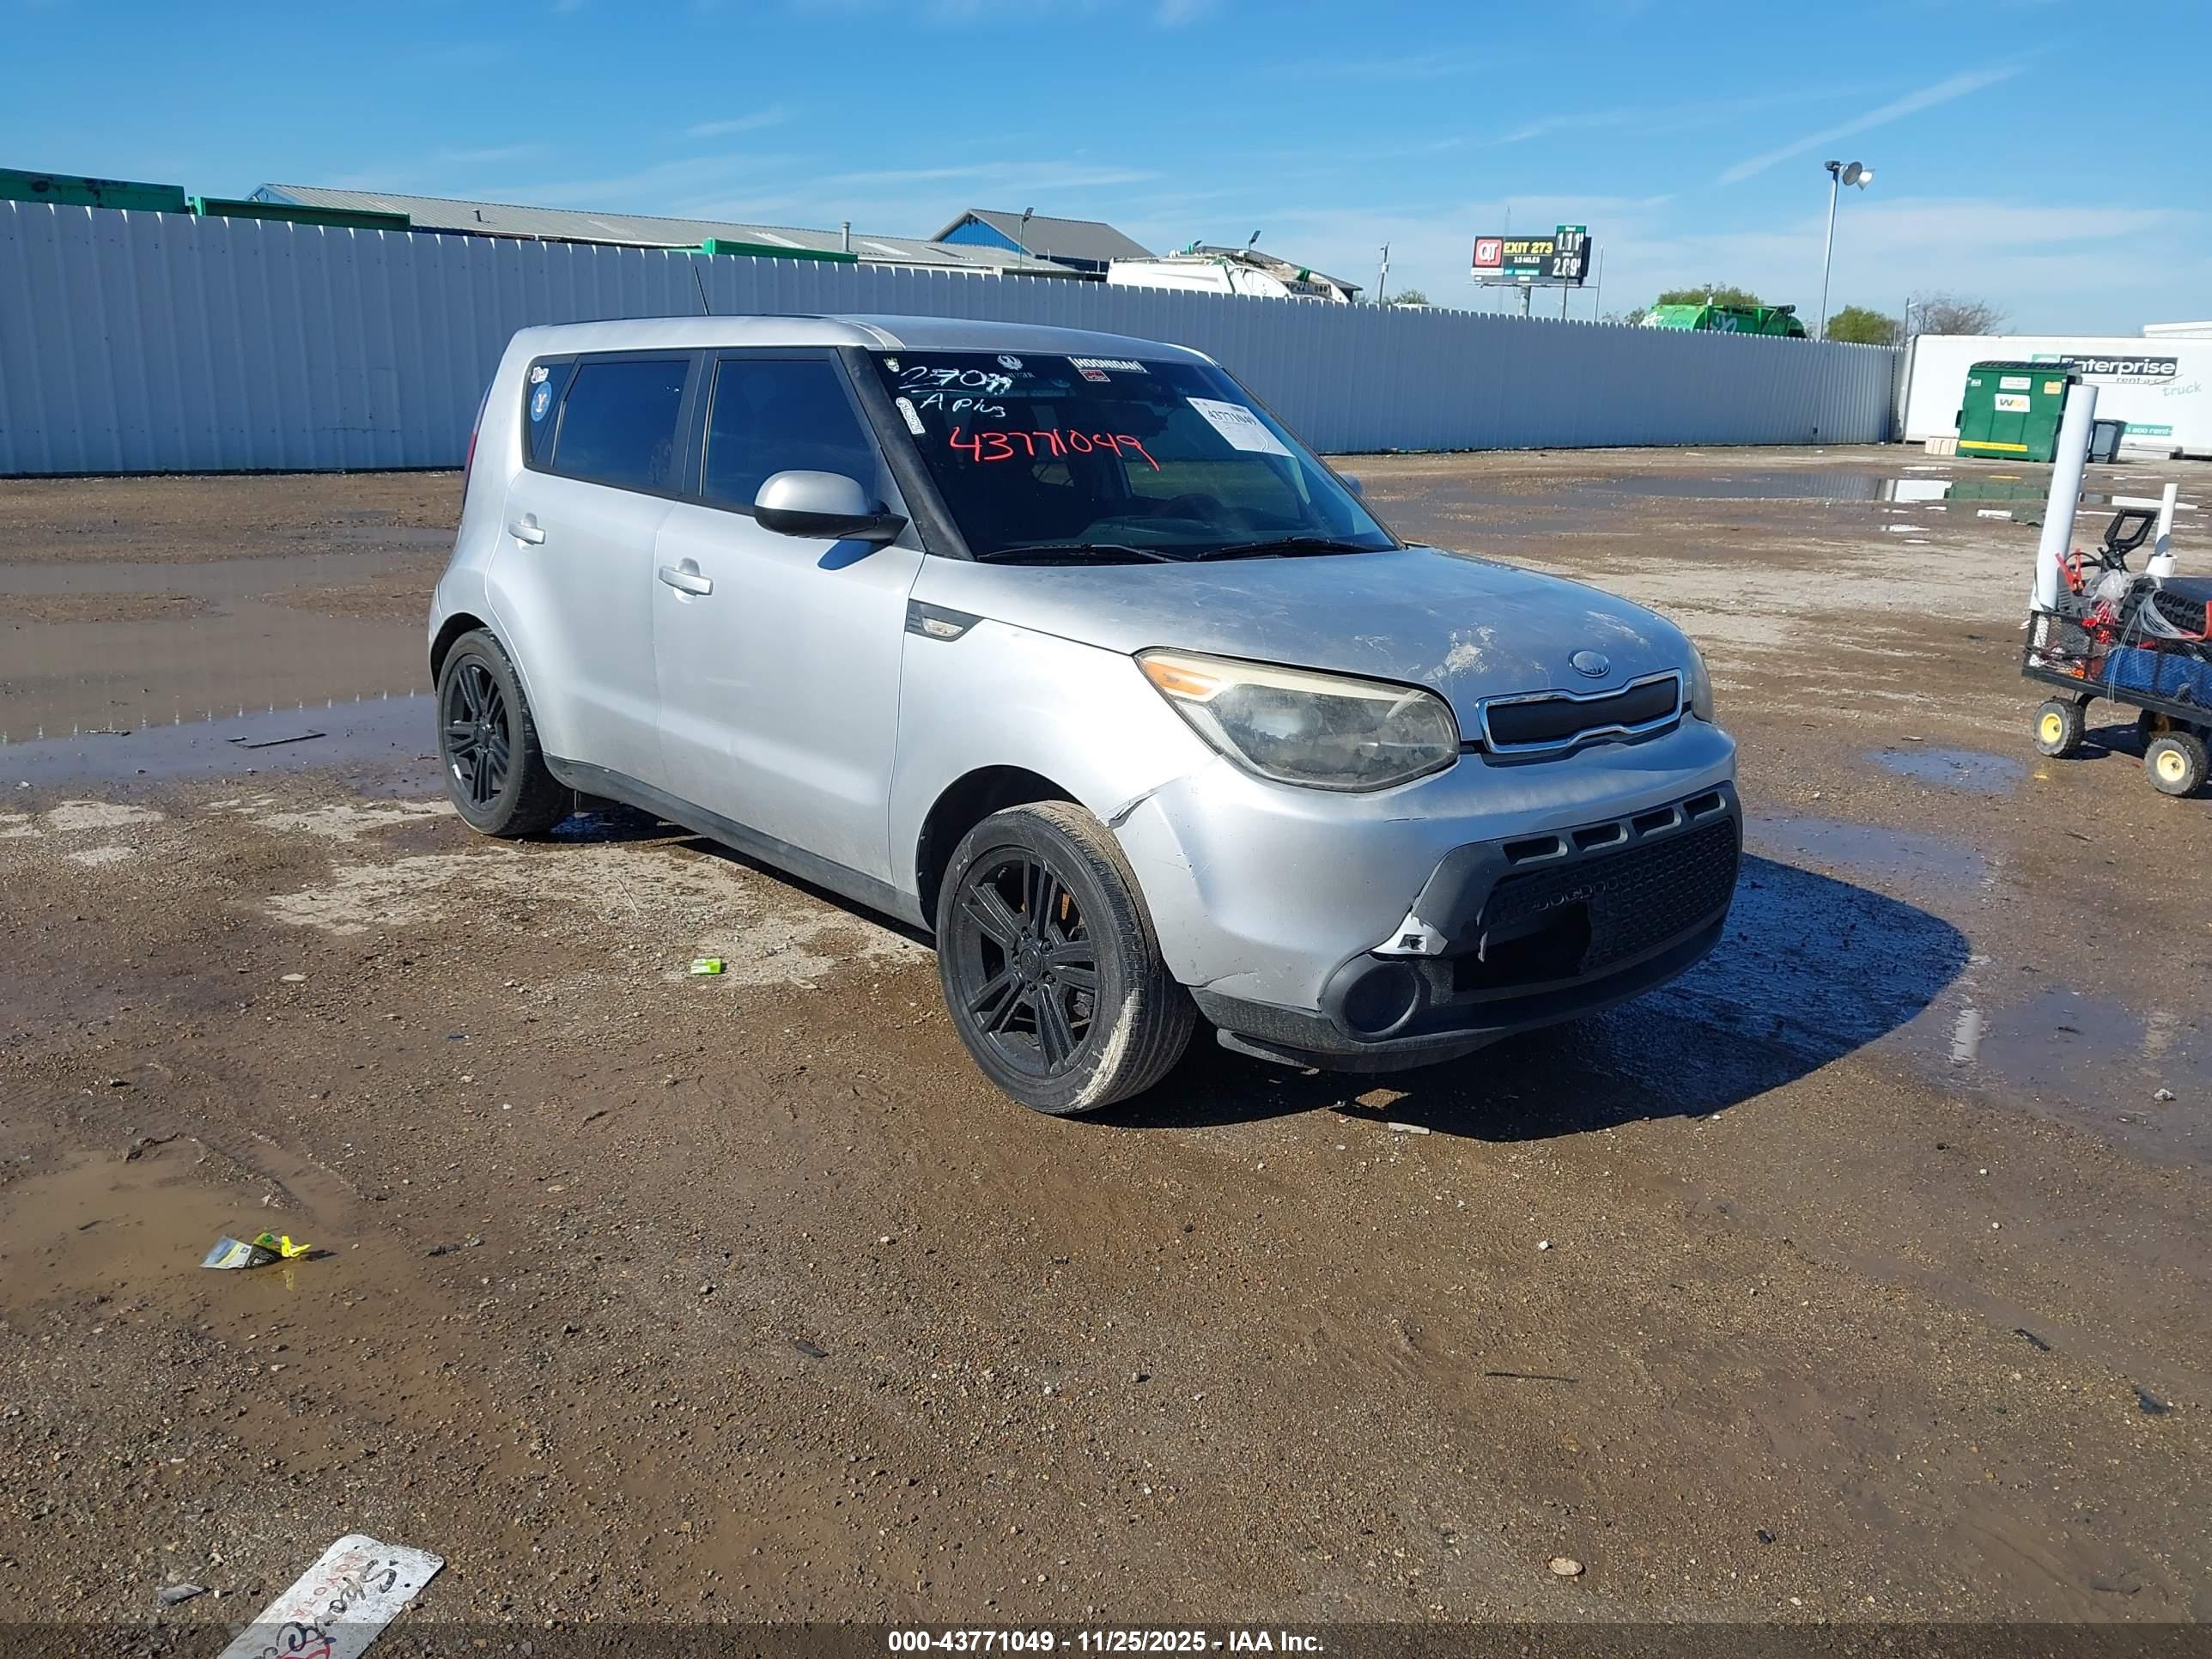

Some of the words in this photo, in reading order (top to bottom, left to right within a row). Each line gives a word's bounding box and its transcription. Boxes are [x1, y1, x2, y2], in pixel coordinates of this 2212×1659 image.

[1478, 241, 1499, 264] QT
[1504, 241, 1529, 253] EXIT
[1531, 241, 1553, 253] 273
[2162, 381, 2203, 397] truck
[950, 426, 1160, 471] 43771049
